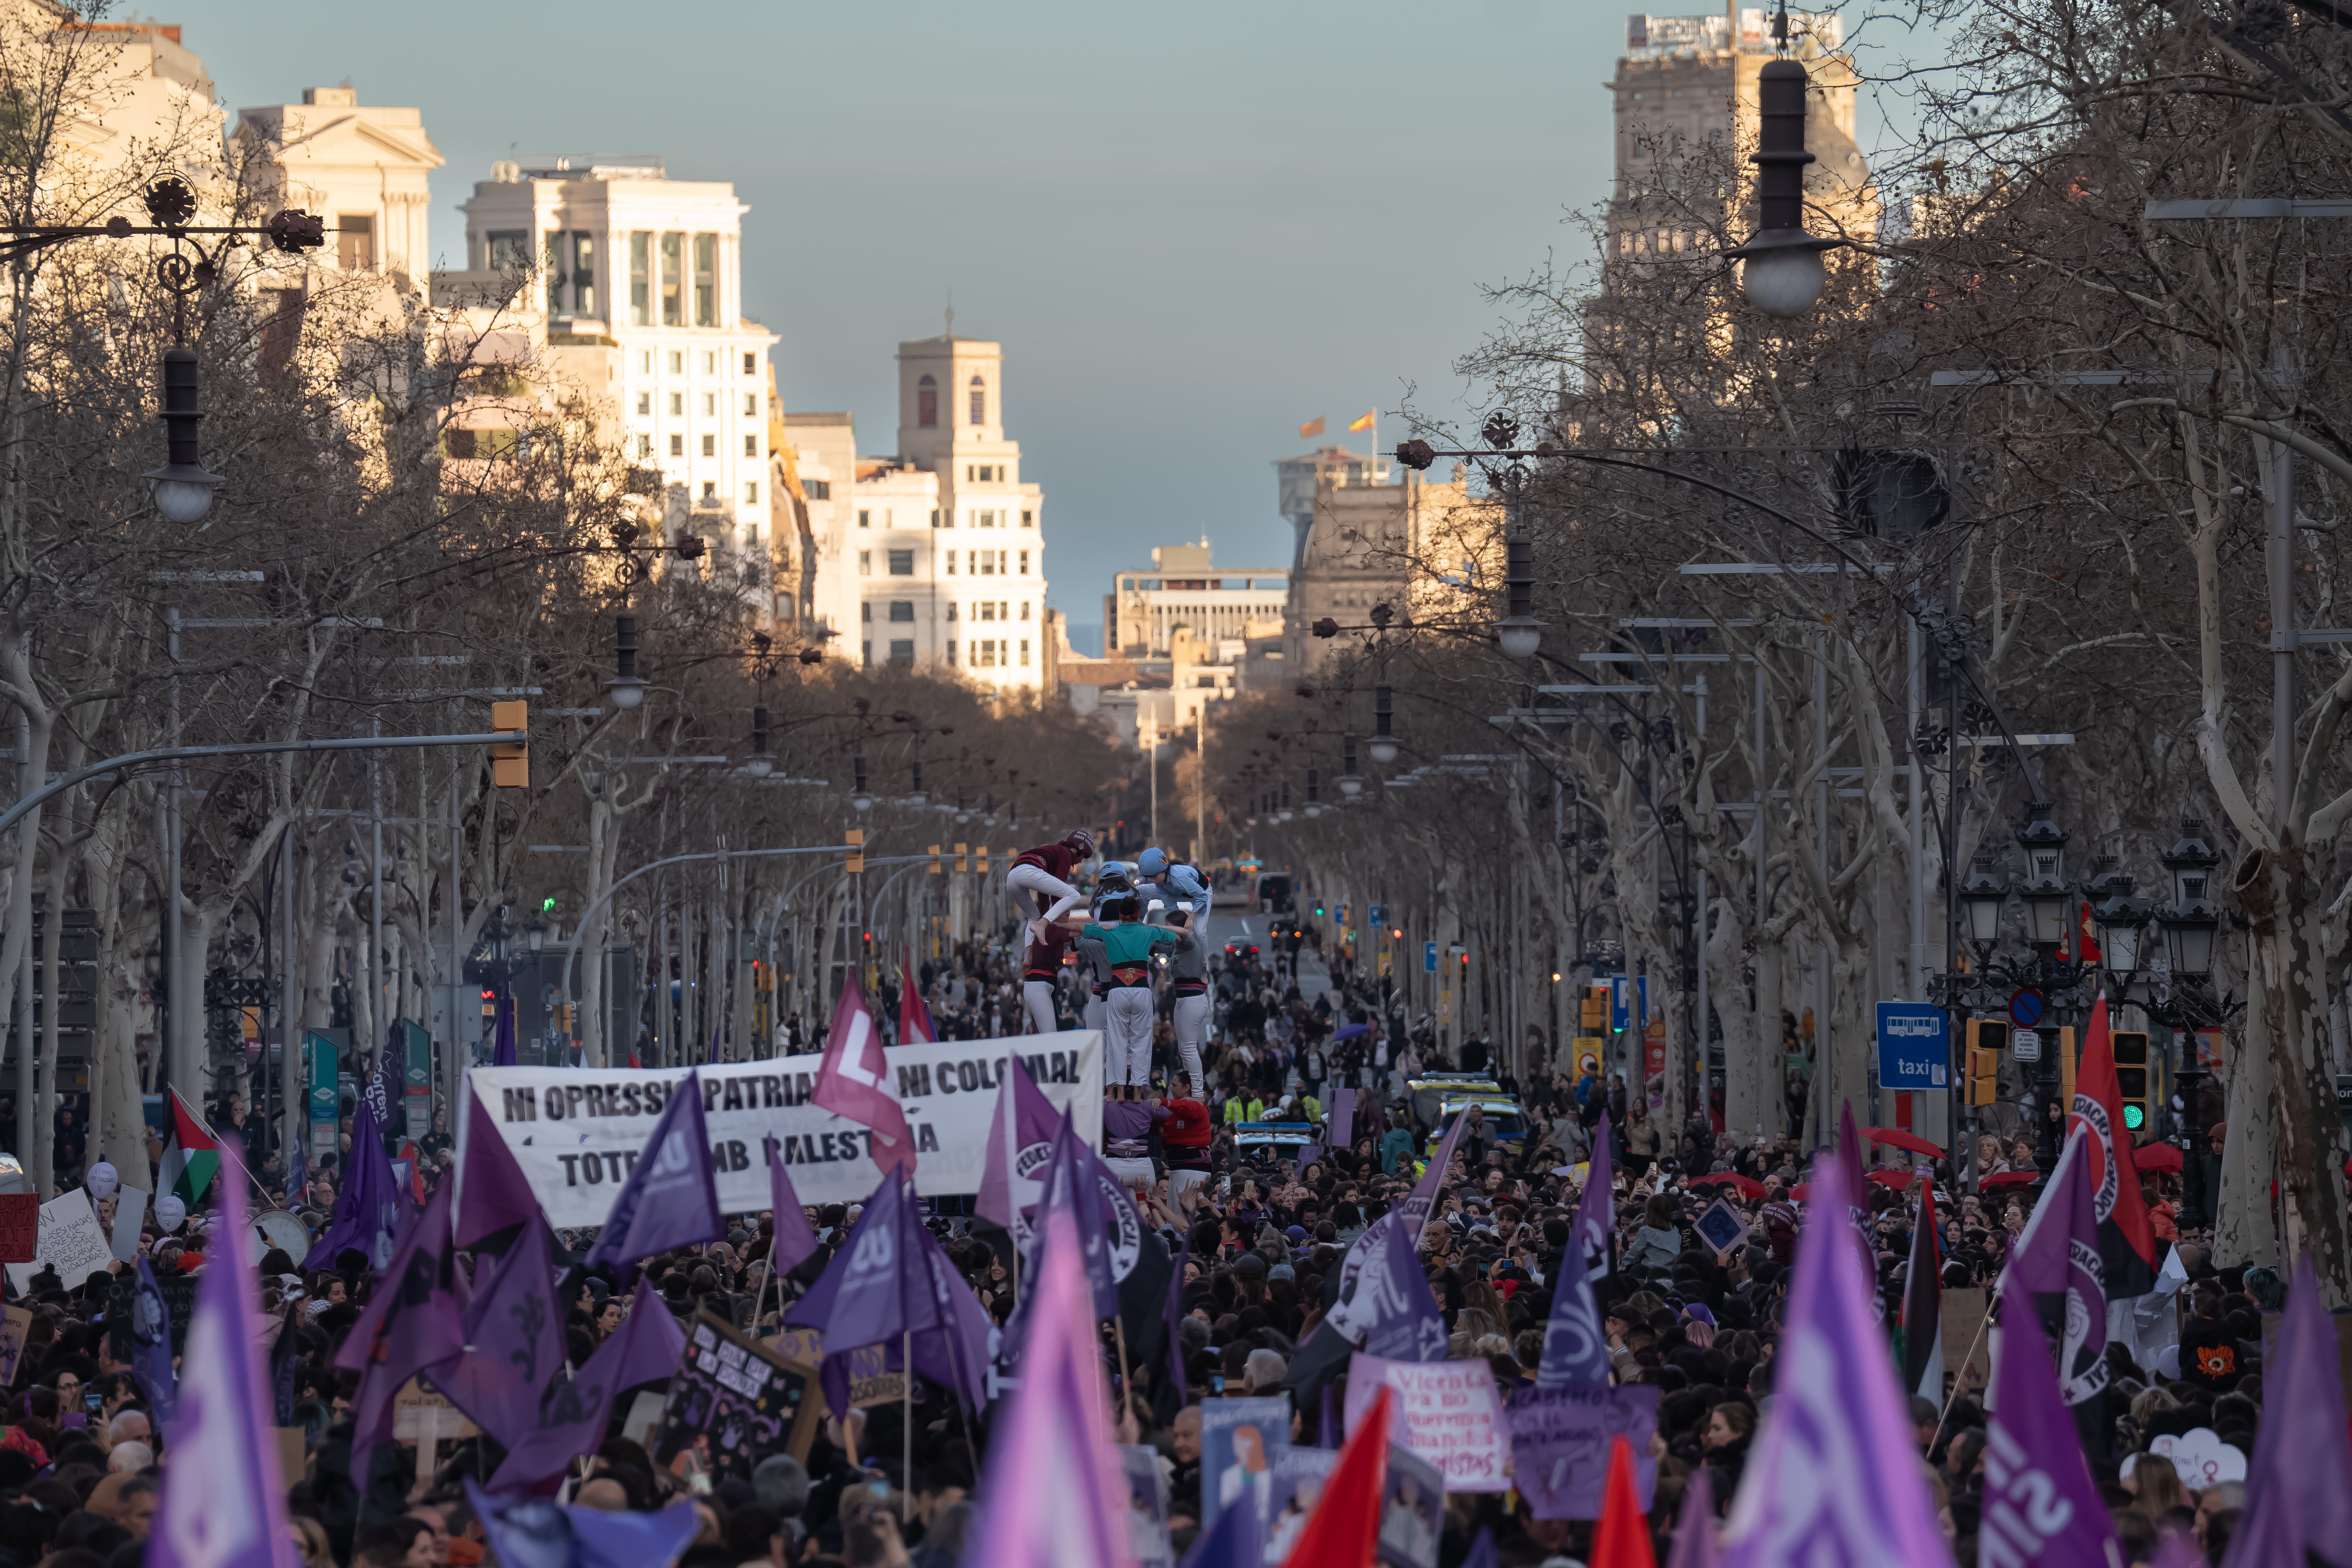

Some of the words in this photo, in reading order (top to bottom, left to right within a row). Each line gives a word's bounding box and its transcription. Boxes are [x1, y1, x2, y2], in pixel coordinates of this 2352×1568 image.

[1898, 1059, 1929, 1075] taxi
[502, 1086, 537, 1122] NI
[544, 1080, 688, 1120] OPRESSI
[896, 1063, 933, 1098] NI
[711, 1139, 750, 1173] MB
[48, 1214, 92, 1241] ASESINADAS
[50, 1228, 85, 1250] PRESAS
[1681, 1228, 1691, 1248] SANTS
[54, 1234, 97, 1259] ENFERMAS
[60, 1243, 102, 1267] PRECARIAS
[1397, 1370, 1490, 1389] Vicenta
